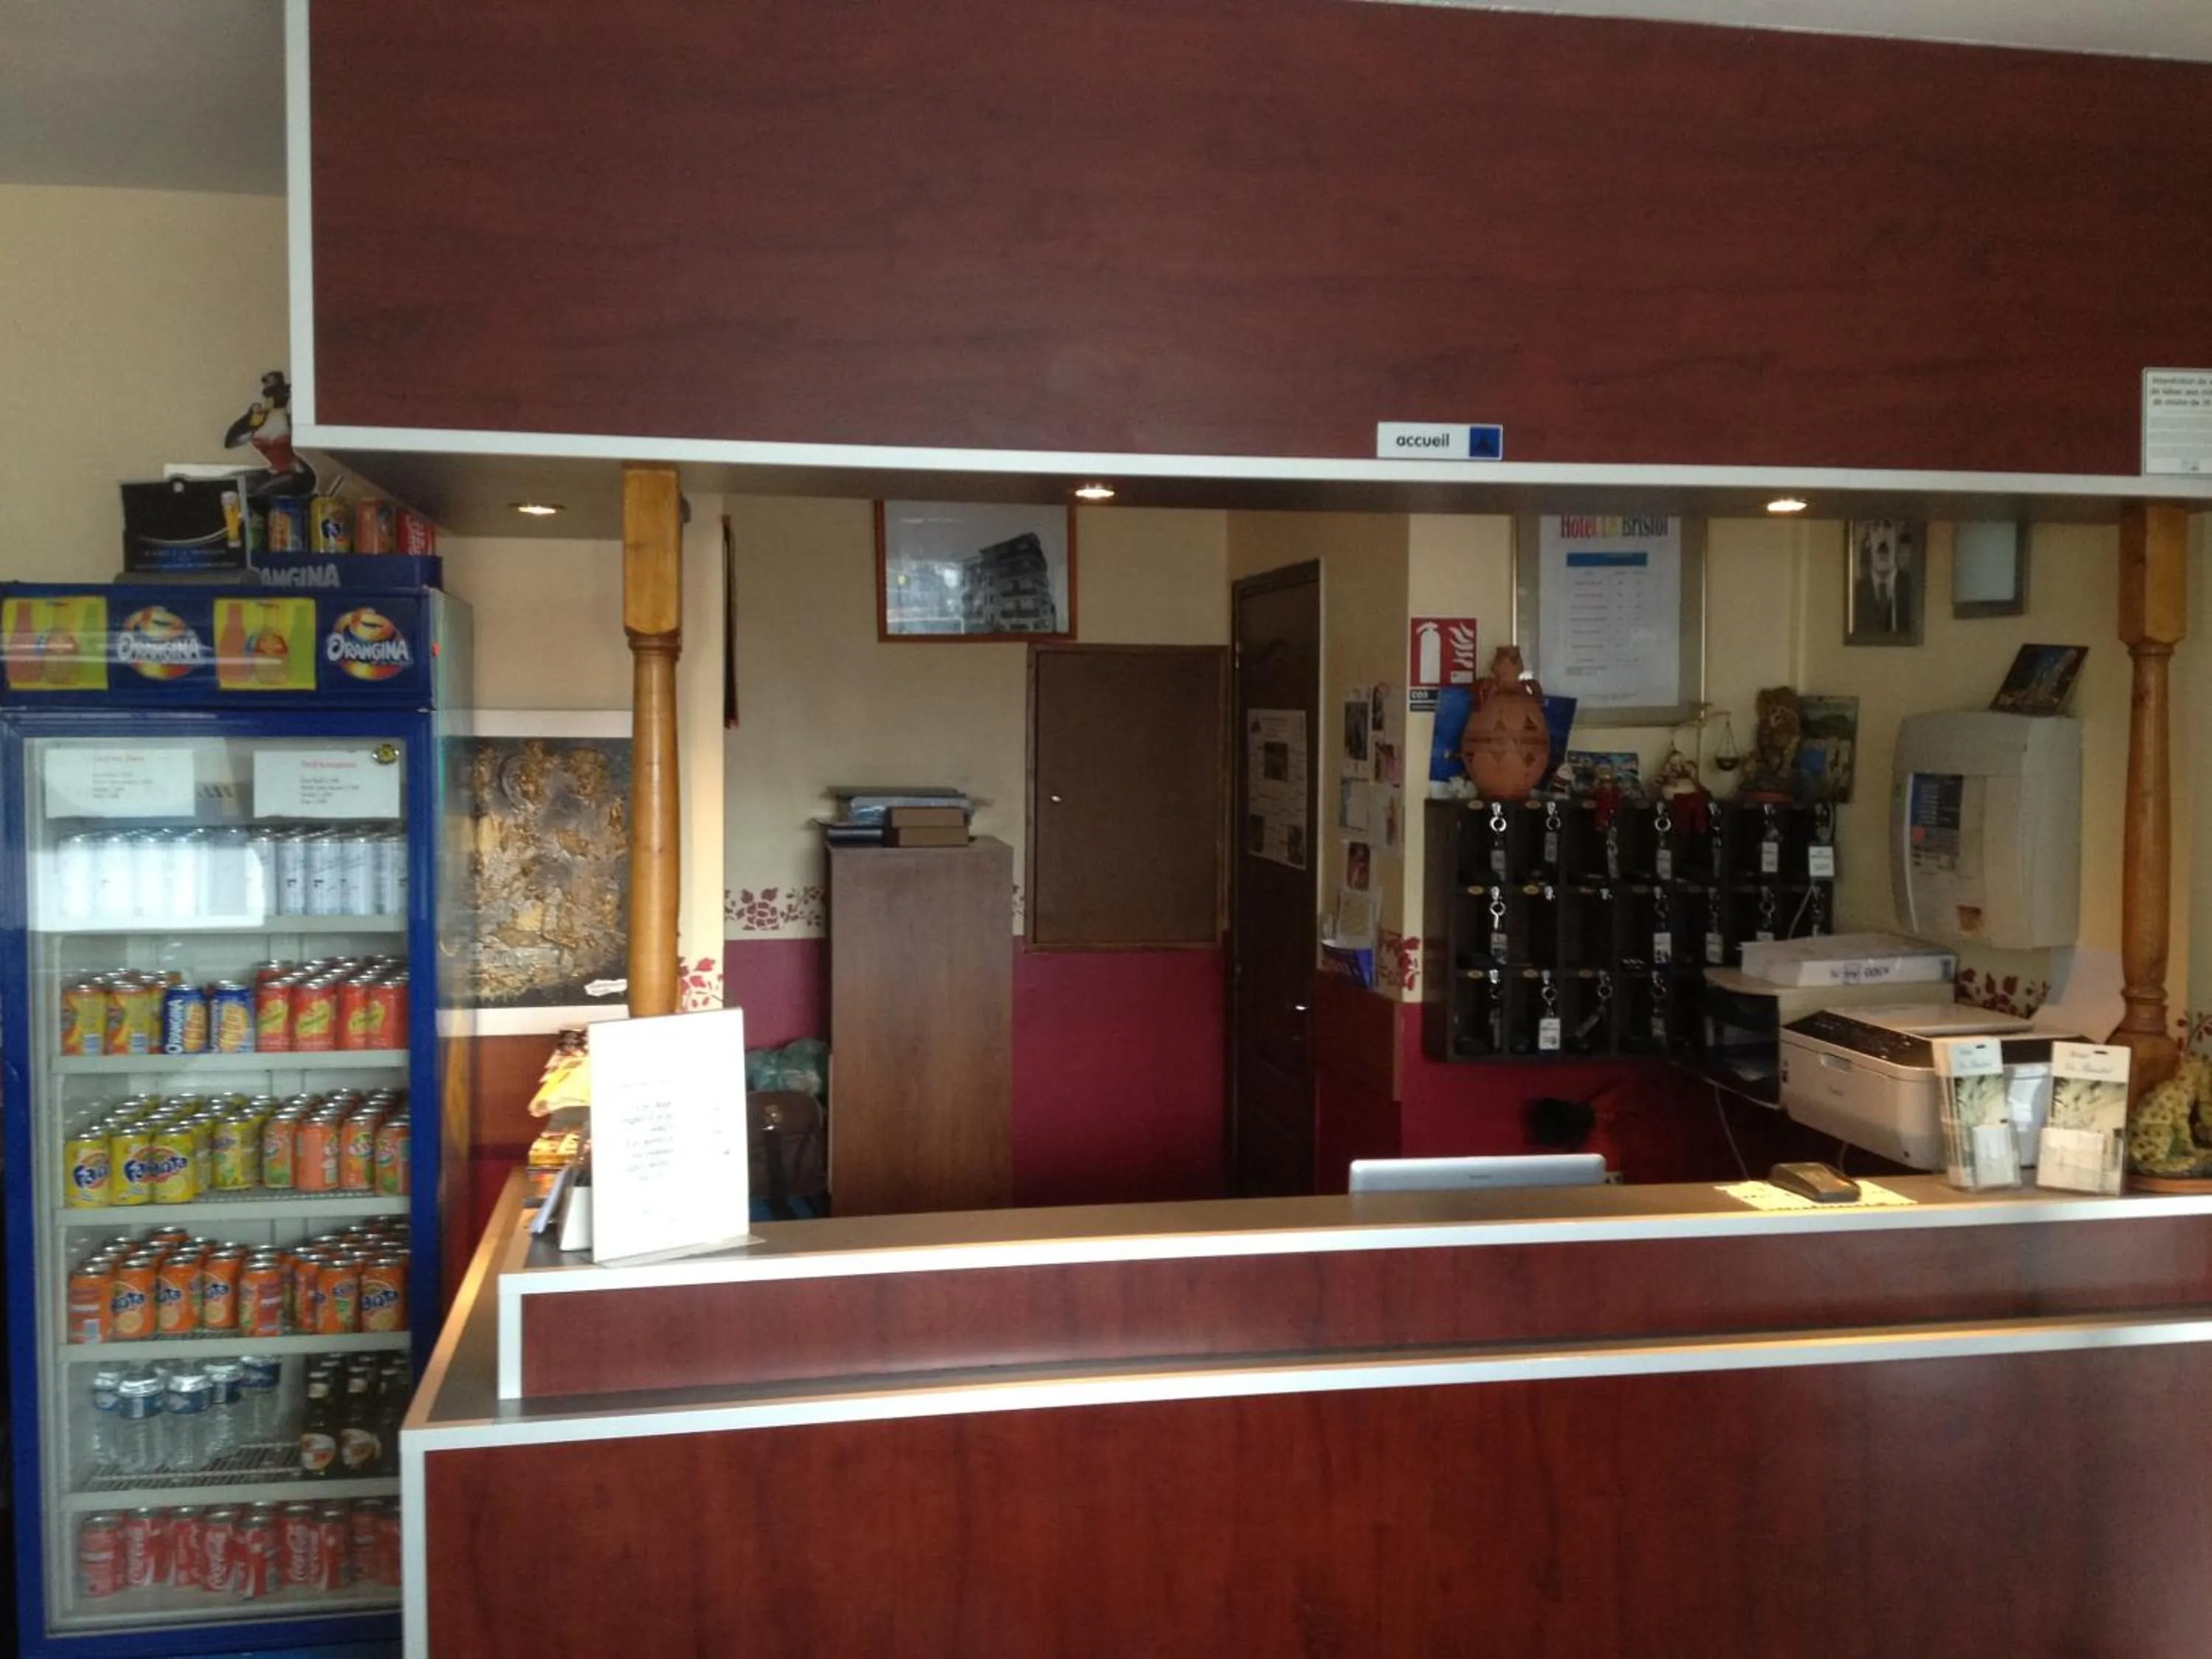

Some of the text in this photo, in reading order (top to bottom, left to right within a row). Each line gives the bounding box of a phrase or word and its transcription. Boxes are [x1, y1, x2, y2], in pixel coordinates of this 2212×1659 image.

[1396, 433, 1450, 448] accueil
[260, 563, 341, 589] ANGINA
[327, 633, 410, 662] ORANGINA
